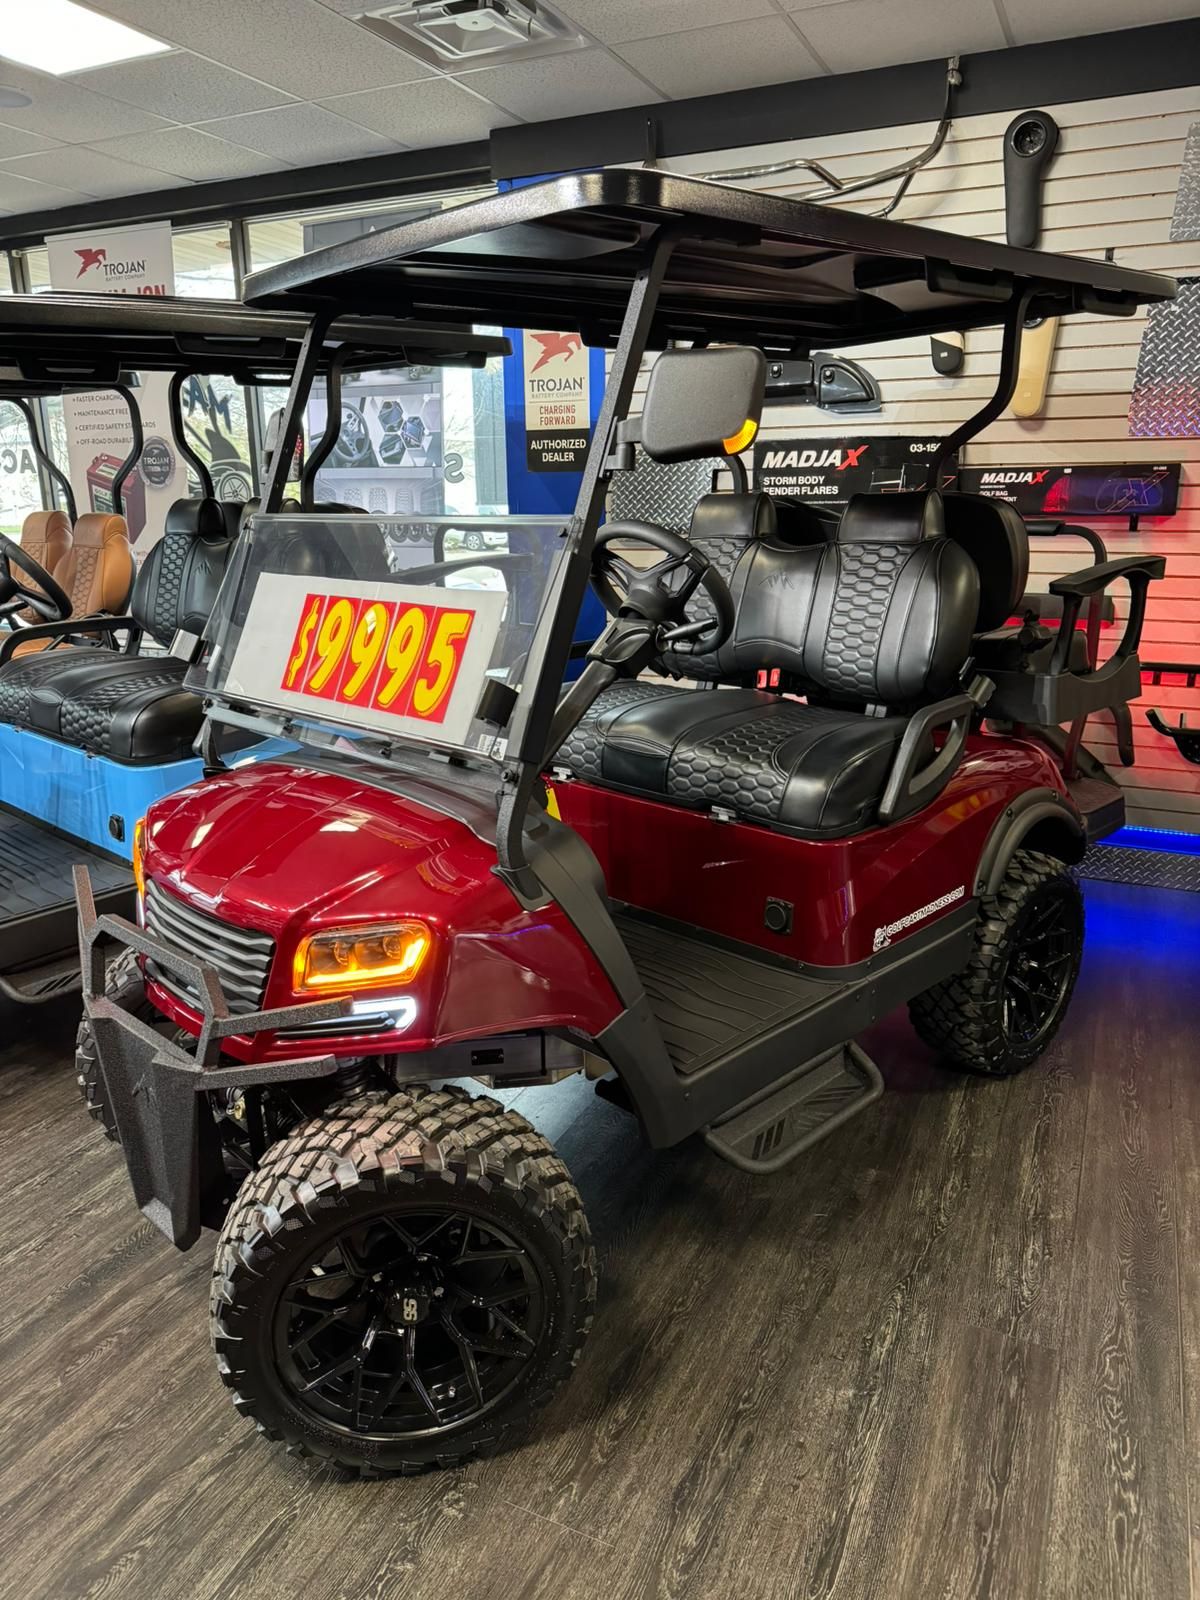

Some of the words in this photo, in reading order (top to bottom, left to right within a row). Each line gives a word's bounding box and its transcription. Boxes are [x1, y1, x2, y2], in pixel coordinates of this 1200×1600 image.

[103, 260, 145, 276] TROJAN
[529, 377, 583, 392] TROJAN
[539, 405, 576, 415] CHARGING
[540, 416, 576, 426] FORWARD
[79, 423, 104, 431] CERTIFIED
[530, 438, 587, 450] AUTHORIZED
[143, 457, 169, 465] TROJAN
[542, 452, 575, 462] DEALER
[762, 444, 870, 471] MADJAX
[763, 477, 797, 486] STORM
[798, 475, 825, 485] BODY
[980, 469, 1049, 485] MADJAX
[763, 486, 800, 496] FENDER
[801, 485, 839, 495] FLARES
[286, 597, 473, 716] $9995
[886, 885, 965, 936] GOLFCARTMADNESS.COM
